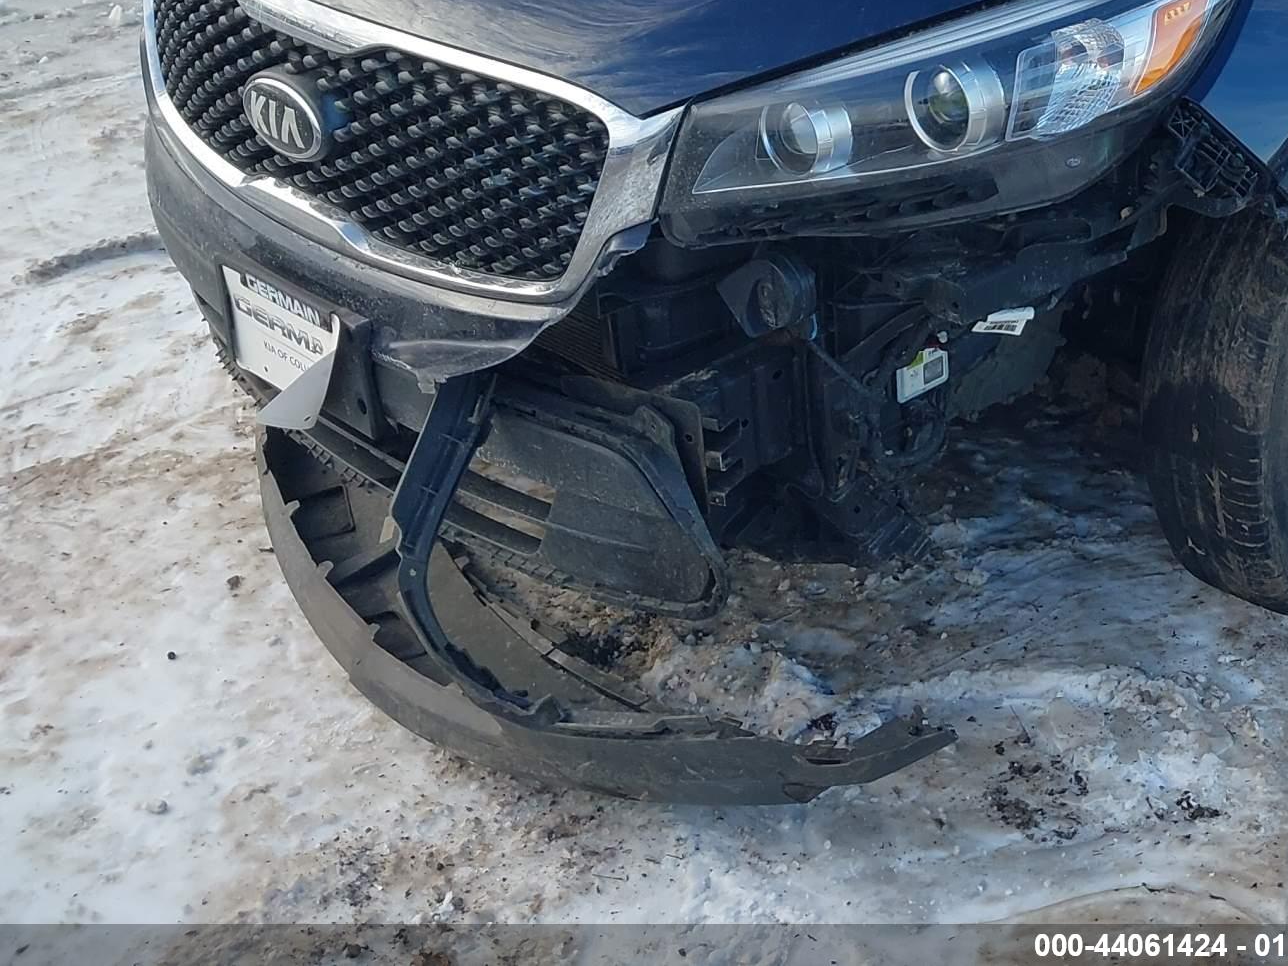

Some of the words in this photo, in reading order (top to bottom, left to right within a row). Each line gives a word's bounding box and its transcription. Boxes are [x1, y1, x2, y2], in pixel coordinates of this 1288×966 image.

[250, 90, 306, 150] KIA
[245, 273, 321, 327] GERMAIN
[277, 348, 288, 363] OF
